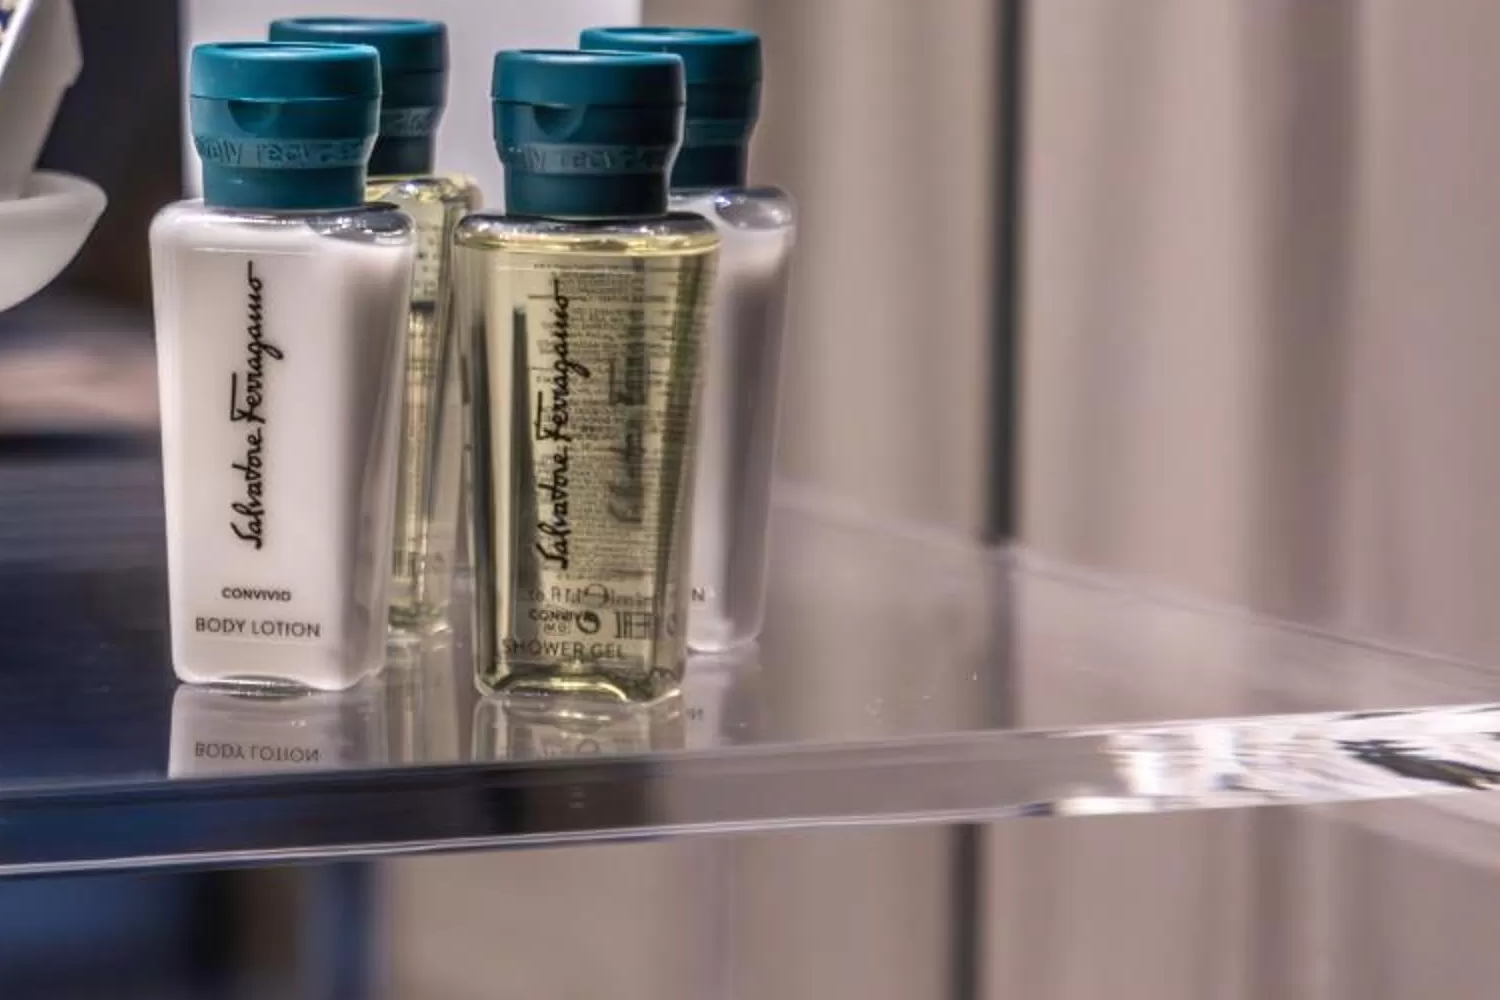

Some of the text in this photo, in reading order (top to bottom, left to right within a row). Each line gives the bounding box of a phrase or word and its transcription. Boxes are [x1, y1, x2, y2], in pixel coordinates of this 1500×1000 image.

[230, 260, 285, 550] Salvatore Ferragamo
[536, 278, 591, 442] Ferragamo
[535, 446, 571, 570] Salvatore
[195, 616, 321, 638] BODY LOTION
[503, 638, 625, 659] SHOWER GEL
